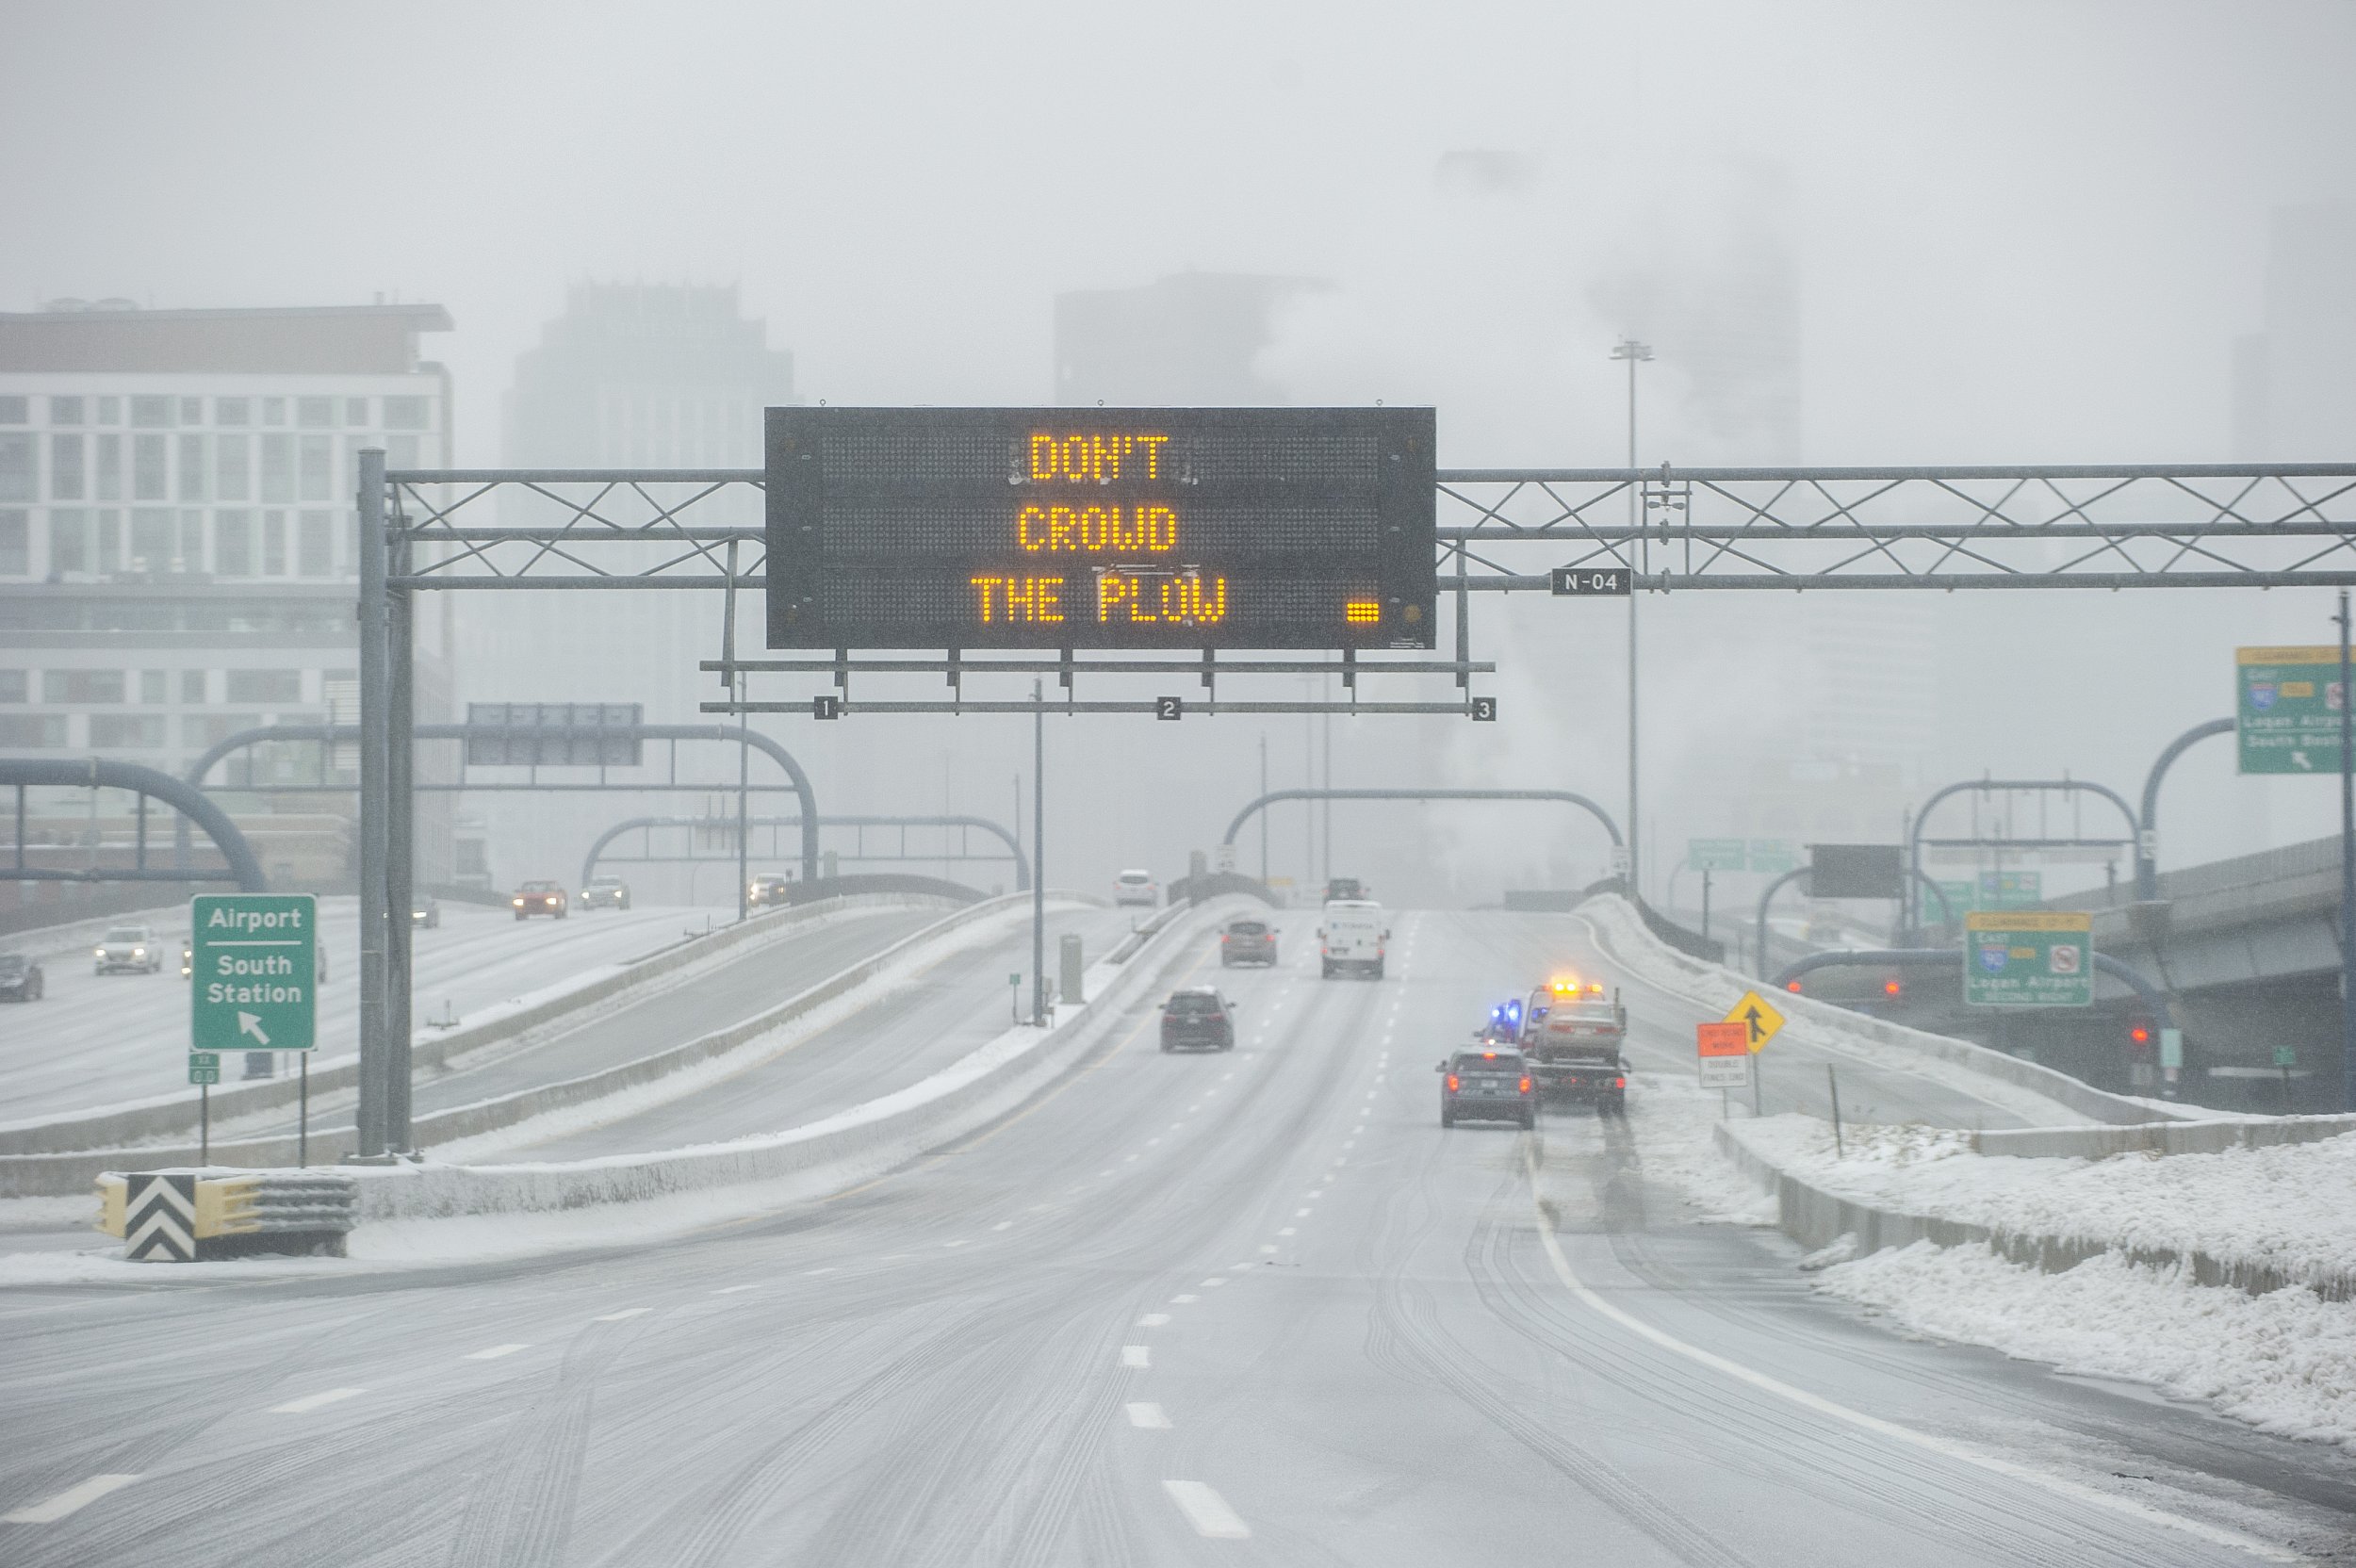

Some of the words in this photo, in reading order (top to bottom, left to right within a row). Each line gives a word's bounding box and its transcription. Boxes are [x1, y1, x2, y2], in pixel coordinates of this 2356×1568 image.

[1032, 435, 1169, 479] DON'T
[1020, 507, 1176, 550] CROWD
[1565, 574, 1618, 590] N-04
[971, 578, 1064, 622] THE
[1100, 578, 1225, 622] PLOW
[822, 700, 830, 716] 1
[1162, 700, 1176, 716] 2
[1478, 701, 1491, 717] 3
[208, 907, 302, 933] Airport
[218, 955, 292, 975] South
[1970, 976, 2021, 989] Logan
[2027, 975, 2089, 989] Airport
[207, 982, 302, 1003] Station
